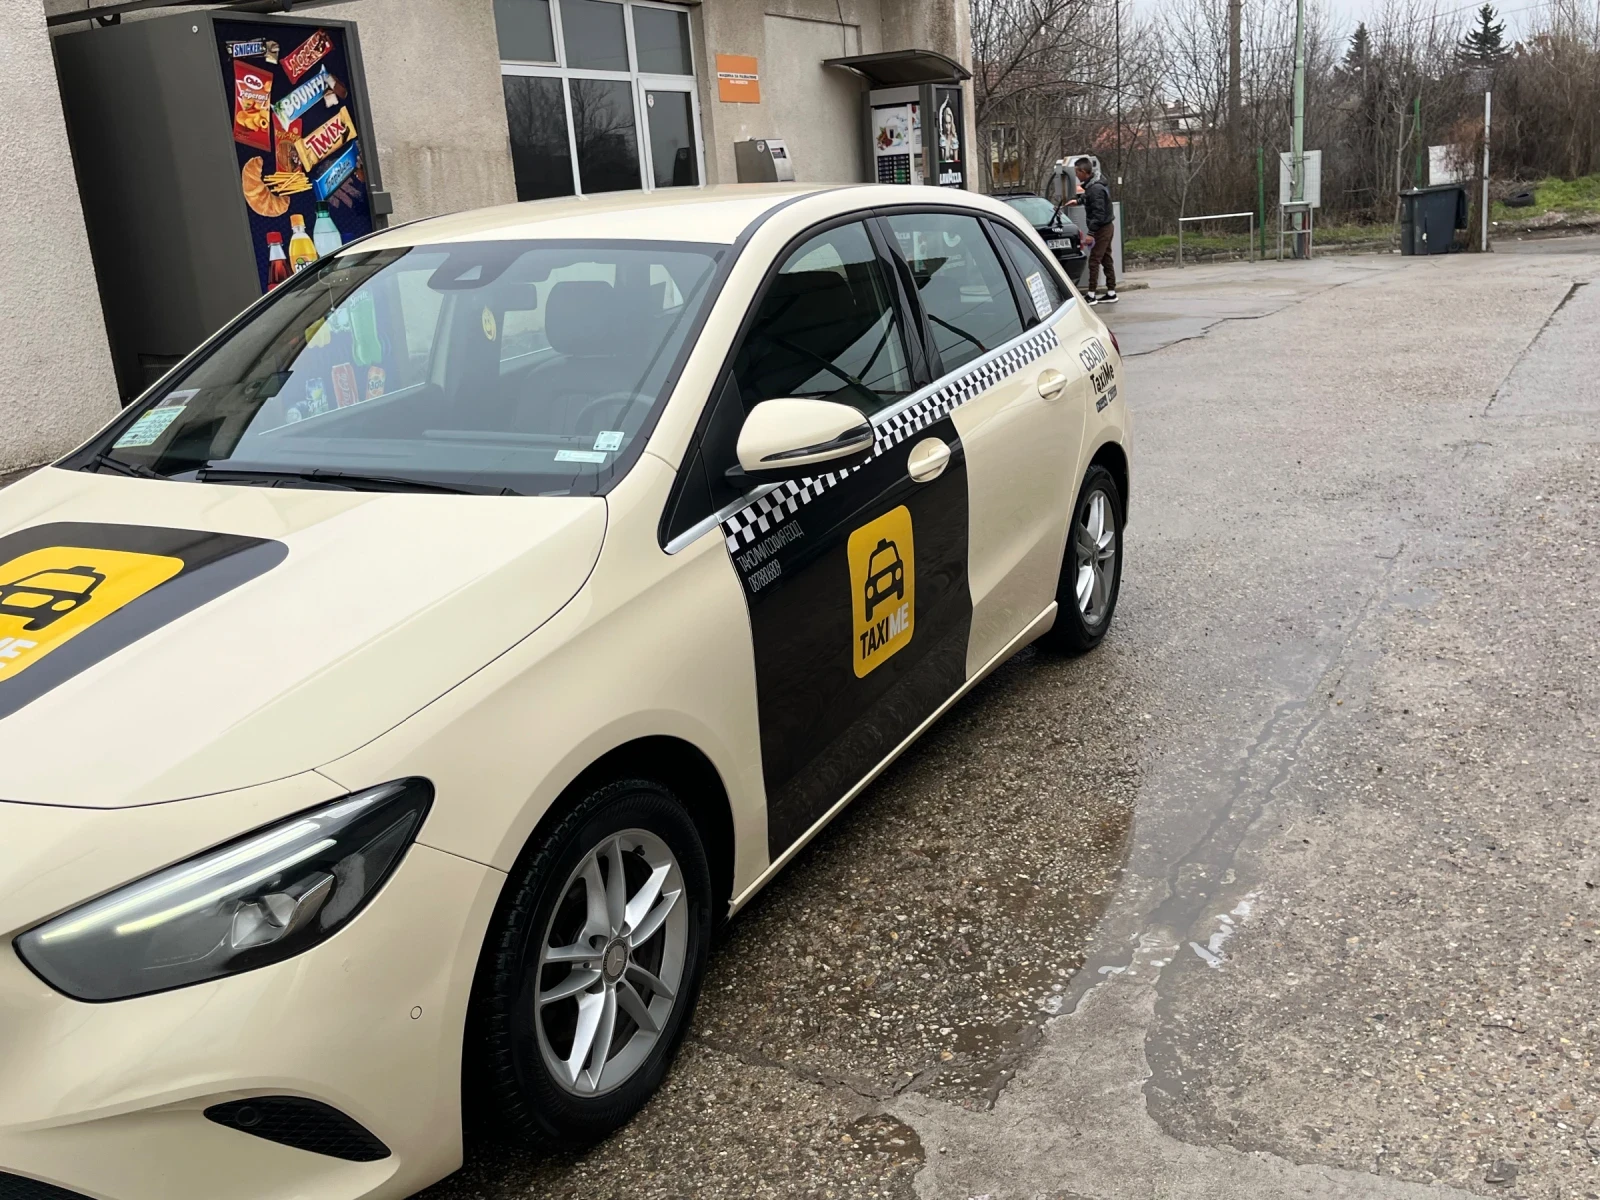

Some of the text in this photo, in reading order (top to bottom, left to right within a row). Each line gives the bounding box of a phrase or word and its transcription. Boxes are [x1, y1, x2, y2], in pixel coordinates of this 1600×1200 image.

[245, 76, 262, 88] Chio
[281, 74, 325, 117] BOUNTY
[305, 118, 346, 157] TWIX
[1090, 361, 1115, 395] TaxiMe
